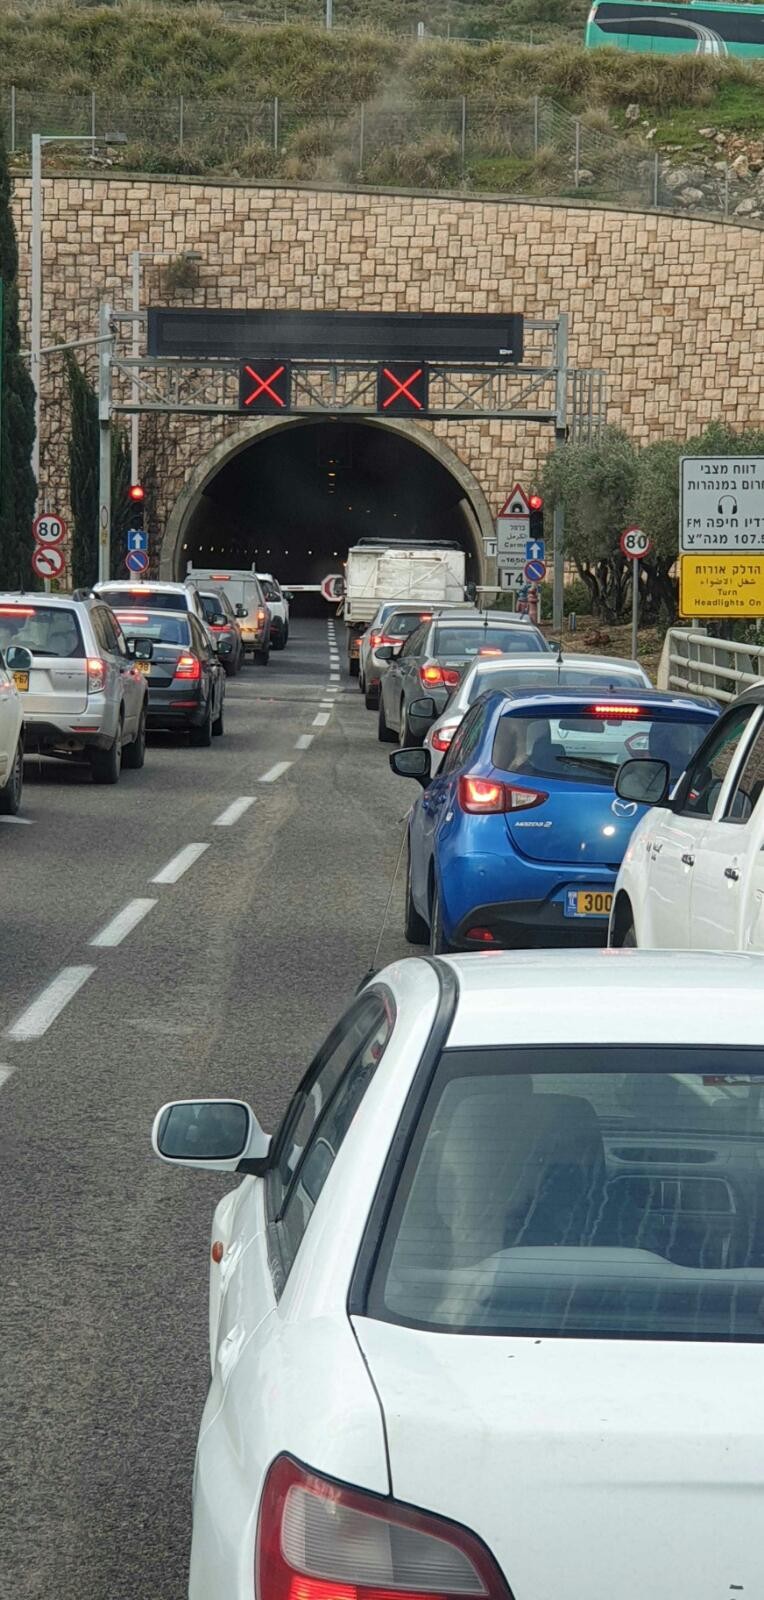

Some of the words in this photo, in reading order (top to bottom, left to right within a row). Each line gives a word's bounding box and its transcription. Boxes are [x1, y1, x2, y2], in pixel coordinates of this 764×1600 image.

[700, 464, 728, 475] מצבי
[733, 464, 756, 474] דווח
[687, 480, 737, 490] במנהרות
[687, 518, 701, 528] FM
[706, 518, 739, 528] חיפה
[39, 522, 60, 537] 80
[626, 535, 647, 549] 80
[695, 565, 726, 574] אורות
[732, 564, 761, 575] הדלק
[717, 588, 738, 596] Turn
[694, 599, 745, 608] Headlights
[749, 598, 762, 606] On
[584, 893, 613, 912] 300
